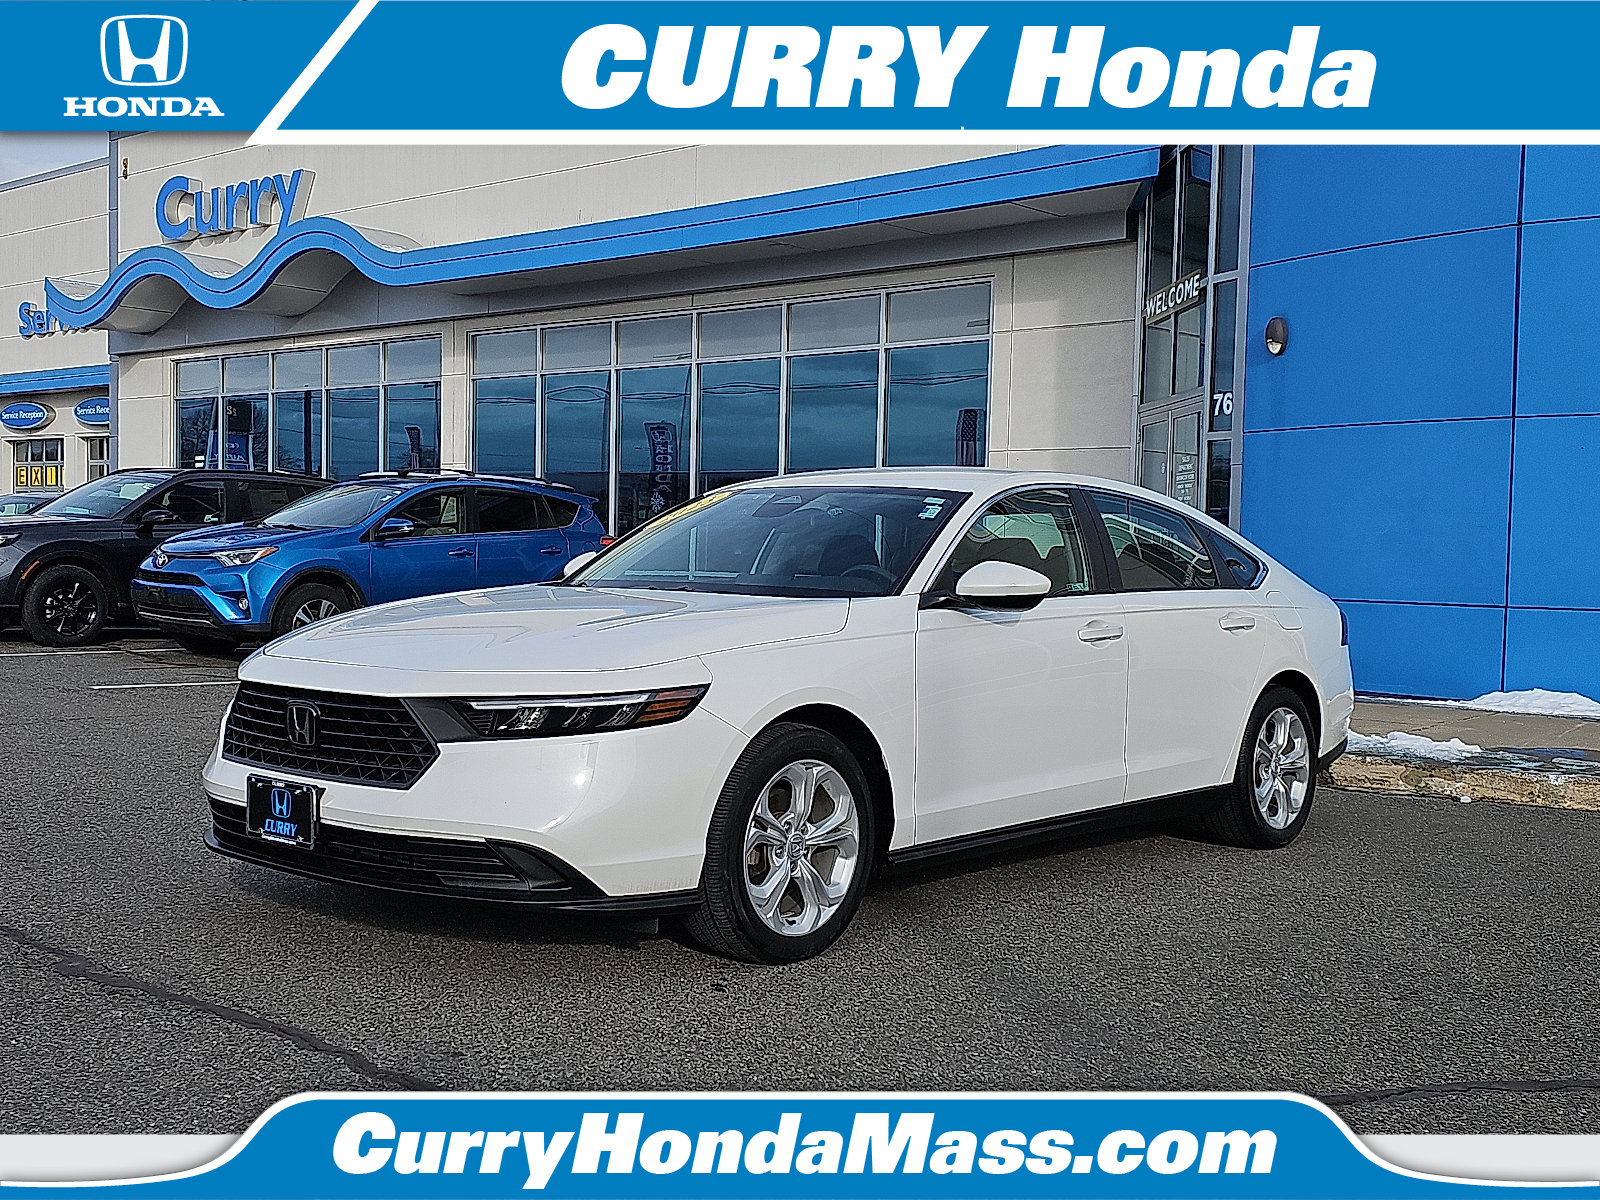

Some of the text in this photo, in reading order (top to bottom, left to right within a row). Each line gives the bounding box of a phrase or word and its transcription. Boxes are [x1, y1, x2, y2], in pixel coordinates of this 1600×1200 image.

[156, 168, 305, 240] Curry
[1146, 274, 1200, 318] WELCOME
[76, 405, 110, 415] Service Rece
[1213, 392, 1233, 416] 76
[19, 410, 43, 420] Reception
[18, 466, 64, 485] EXI
[264, 818, 298, 837] CURRY
